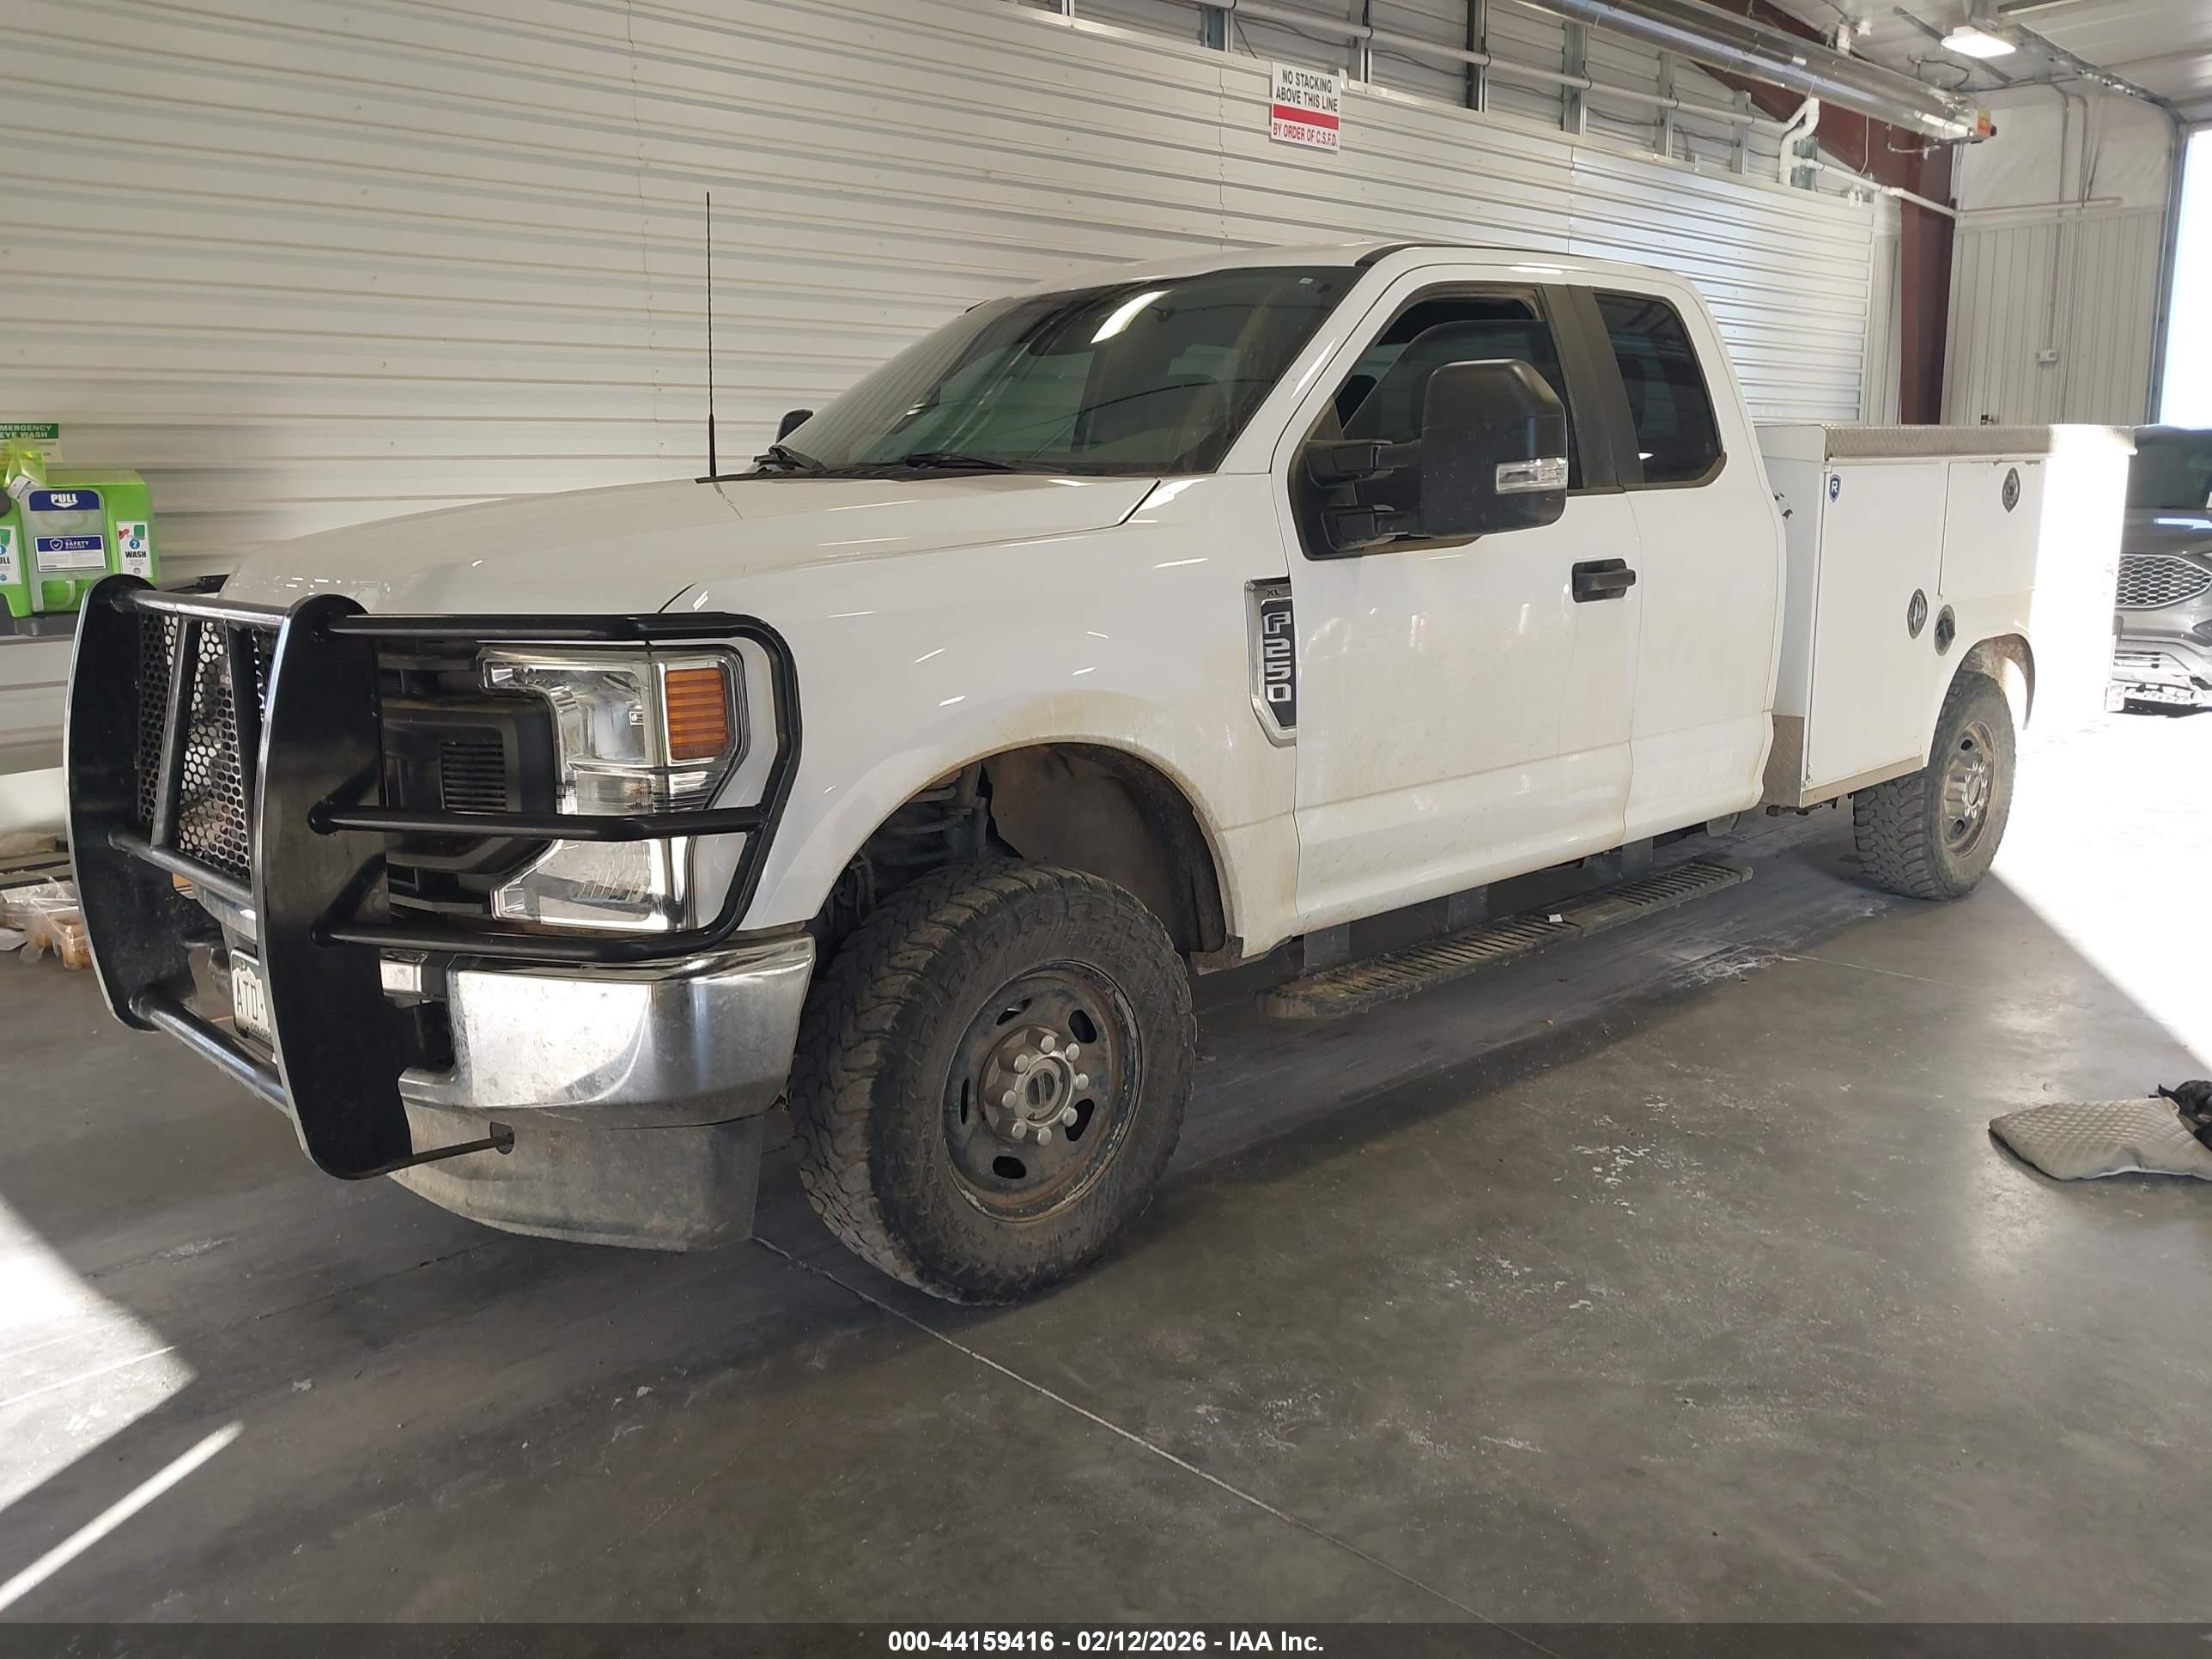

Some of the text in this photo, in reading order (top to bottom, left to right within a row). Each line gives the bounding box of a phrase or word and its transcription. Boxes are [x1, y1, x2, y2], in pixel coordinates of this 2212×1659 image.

[1282, 69, 1332, 94] NO STACKING
[1276, 86, 1338, 112] ABOVE THIS LINE
[1273, 123, 1338, 147] BY ORDER OF C.S.F.D.
[51, 494, 78, 504] PULL
[1832, 481, 1838, 493] R
[1267, 588, 1282, 597] XL
[1263, 611, 1291, 702] F250
